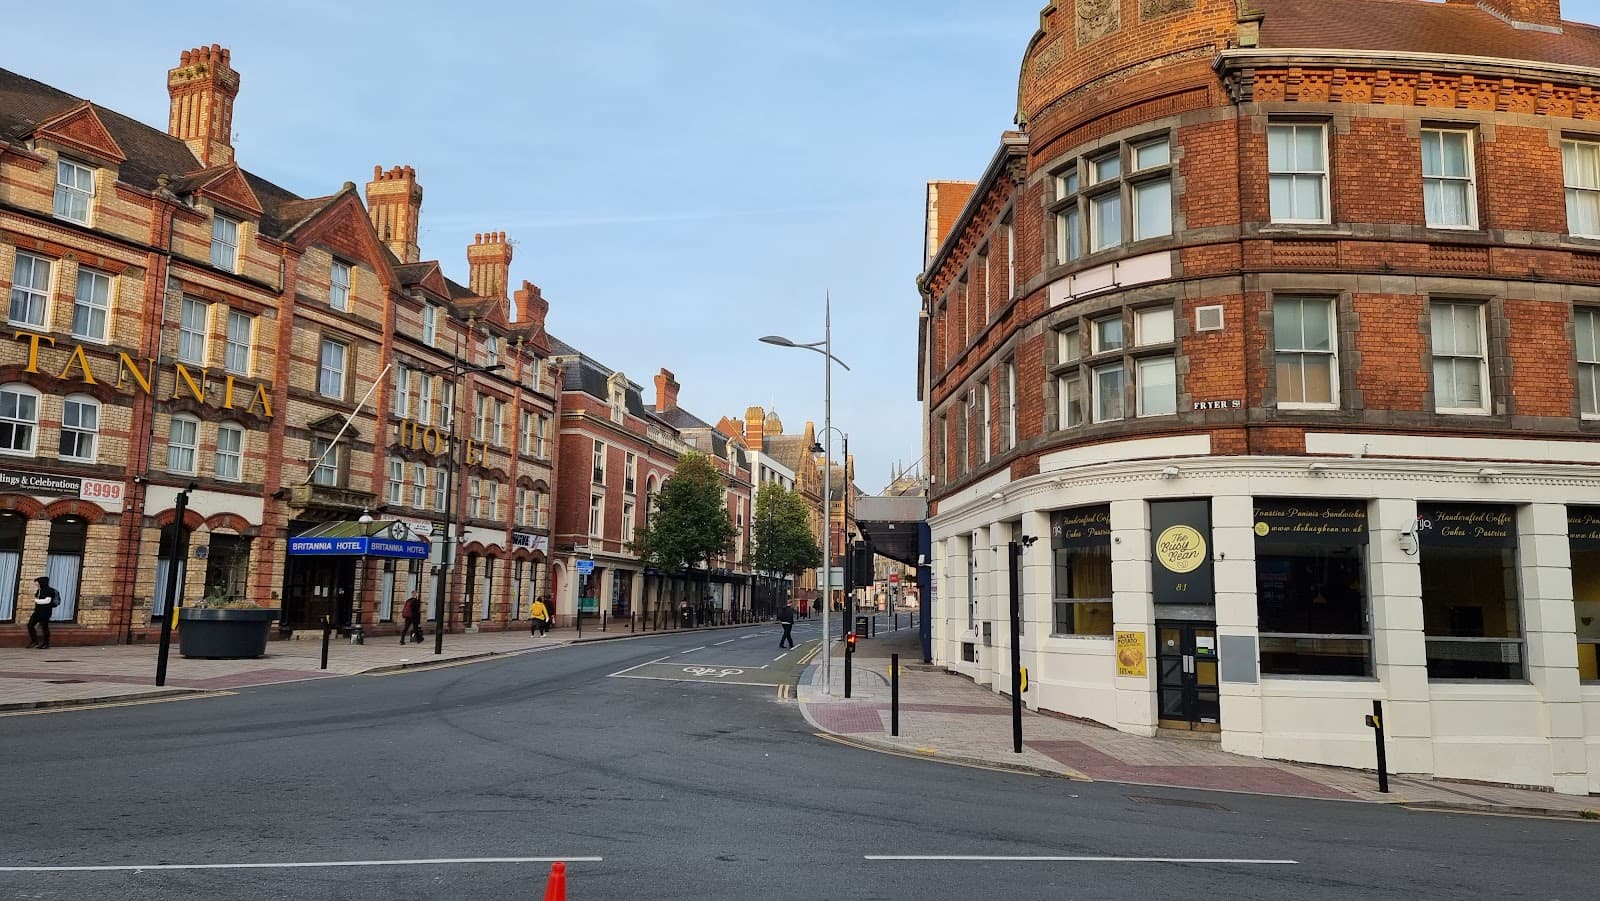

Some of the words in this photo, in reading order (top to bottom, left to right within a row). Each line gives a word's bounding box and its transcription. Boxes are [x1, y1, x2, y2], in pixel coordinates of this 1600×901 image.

[15, 331, 273, 417] TANNIA
[1193, 400, 1227, 409] FRYER
[401, 419, 493, 468] HOEL
[21, 476, 29, 484] &
[29, 476, 80, 490] Celebrations
[83, 482, 121, 499] £999
[1436, 511, 1484, 524] Handcrafted
[1485, 512, 1511, 526] Coffee
[1171, 533, 1189, 544] The
[1441, 526, 1466, 537] Cakes
[1474, 527, 1507, 538] Pastries
[292, 542, 332, 551] BRITANNIA
[336, 541, 361, 550] HOTEL
[371, 542, 403, 552] BRITANNIA
[406, 546, 426, 554] HOTEL
[1160, 540, 1190, 553] Busy
[1168, 549, 1200, 563] Bean
[1175, 583, 1188, 592] 81
